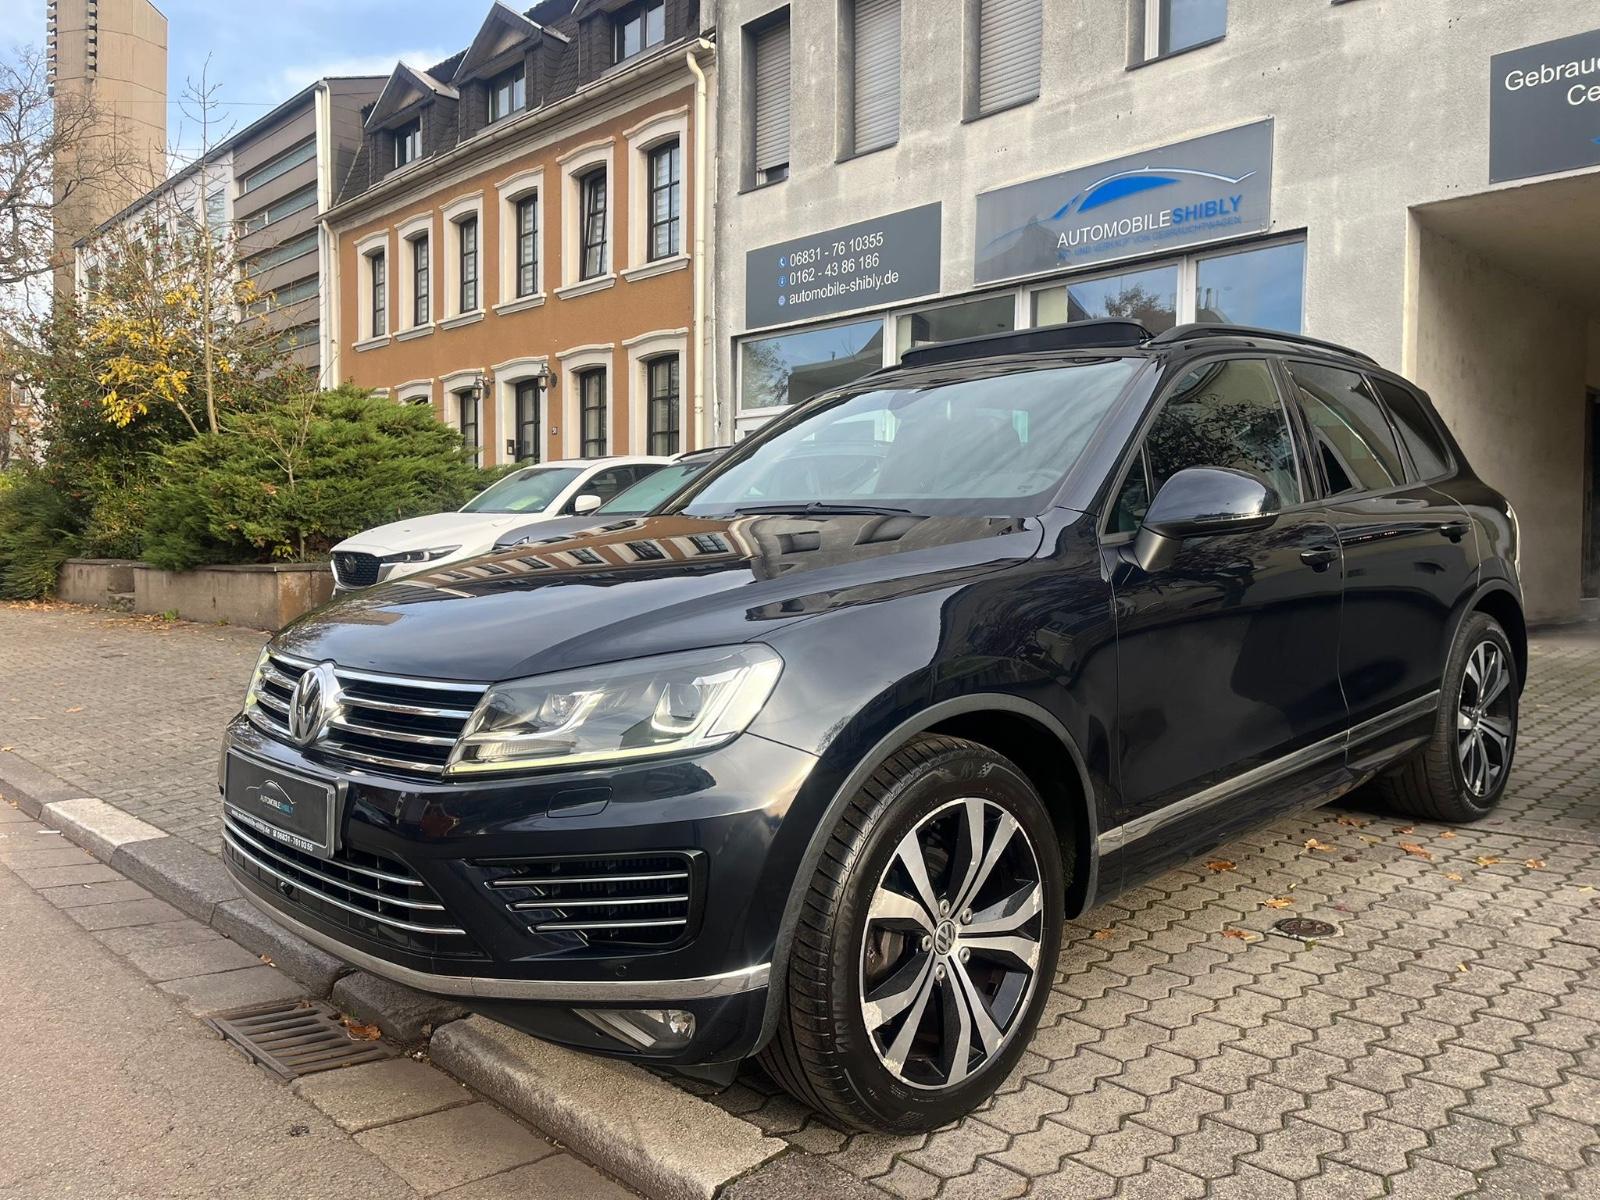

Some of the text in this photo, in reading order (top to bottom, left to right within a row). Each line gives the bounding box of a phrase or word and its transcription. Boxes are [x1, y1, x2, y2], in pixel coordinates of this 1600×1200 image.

[1505, 57, 1600, 91] Gebrau
[1057, 194, 1243, 248] AUTOMOBILESHIBLY
[789, 247, 821, 267] 06831
[832, 241, 846, 257] 76
[849, 231, 884, 253] 10355
[789, 267, 815, 286] 0162
[824, 262, 839, 277] 43
[841, 258, 856, 274] 86
[858, 252, 880, 270] 186
[789, 269, 899, 305] automobile-shibly.de
